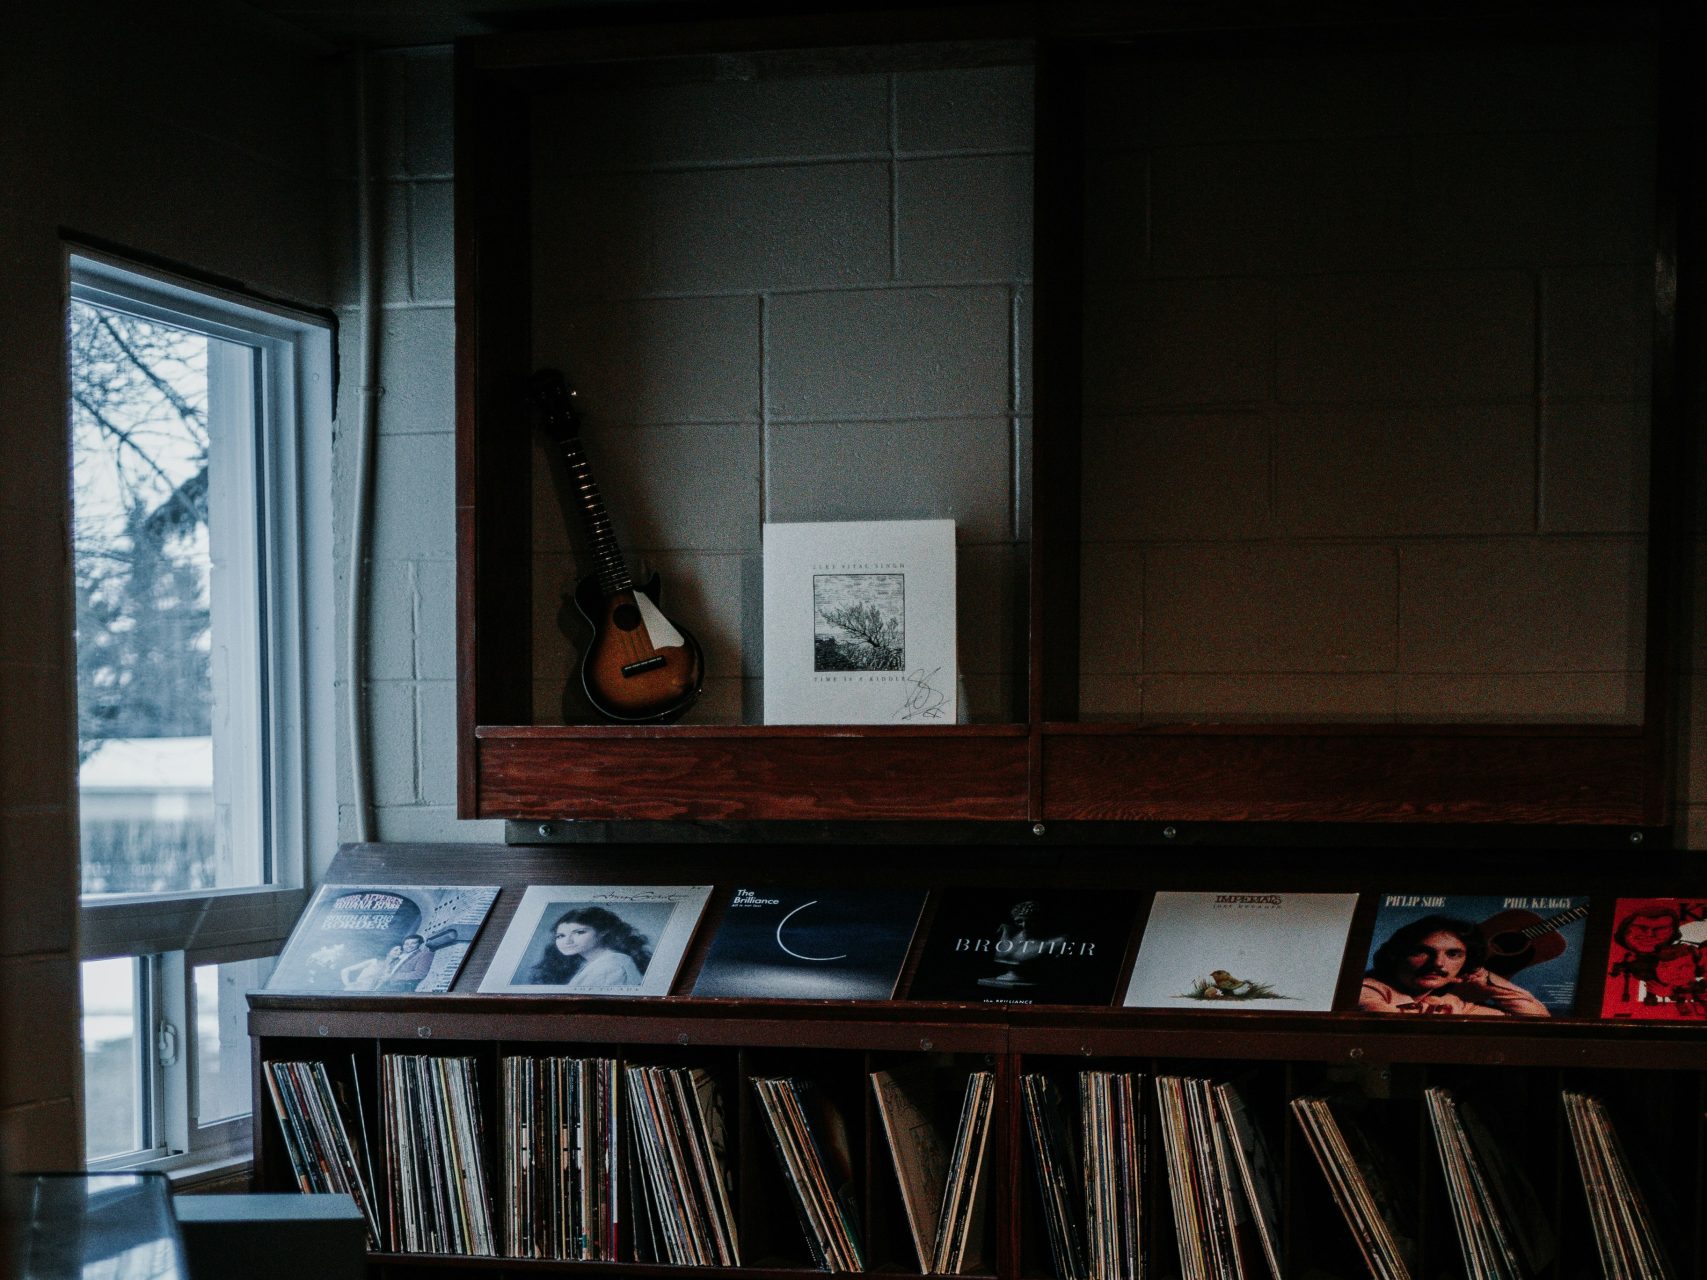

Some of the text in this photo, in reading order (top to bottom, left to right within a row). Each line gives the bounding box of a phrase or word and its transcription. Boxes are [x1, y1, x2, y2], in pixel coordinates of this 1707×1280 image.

[737, 889, 755, 897] The
[733, 896, 780, 905] Brilliance
[1215, 894, 1282, 905] IMPERIALS
[1420, 896, 1446, 908] SIDE
[1503, 897, 1573, 910] PHIL KEAGGY
[321, 919, 390, 930] BORDER
[955, 938, 1096, 956] BROTHER
